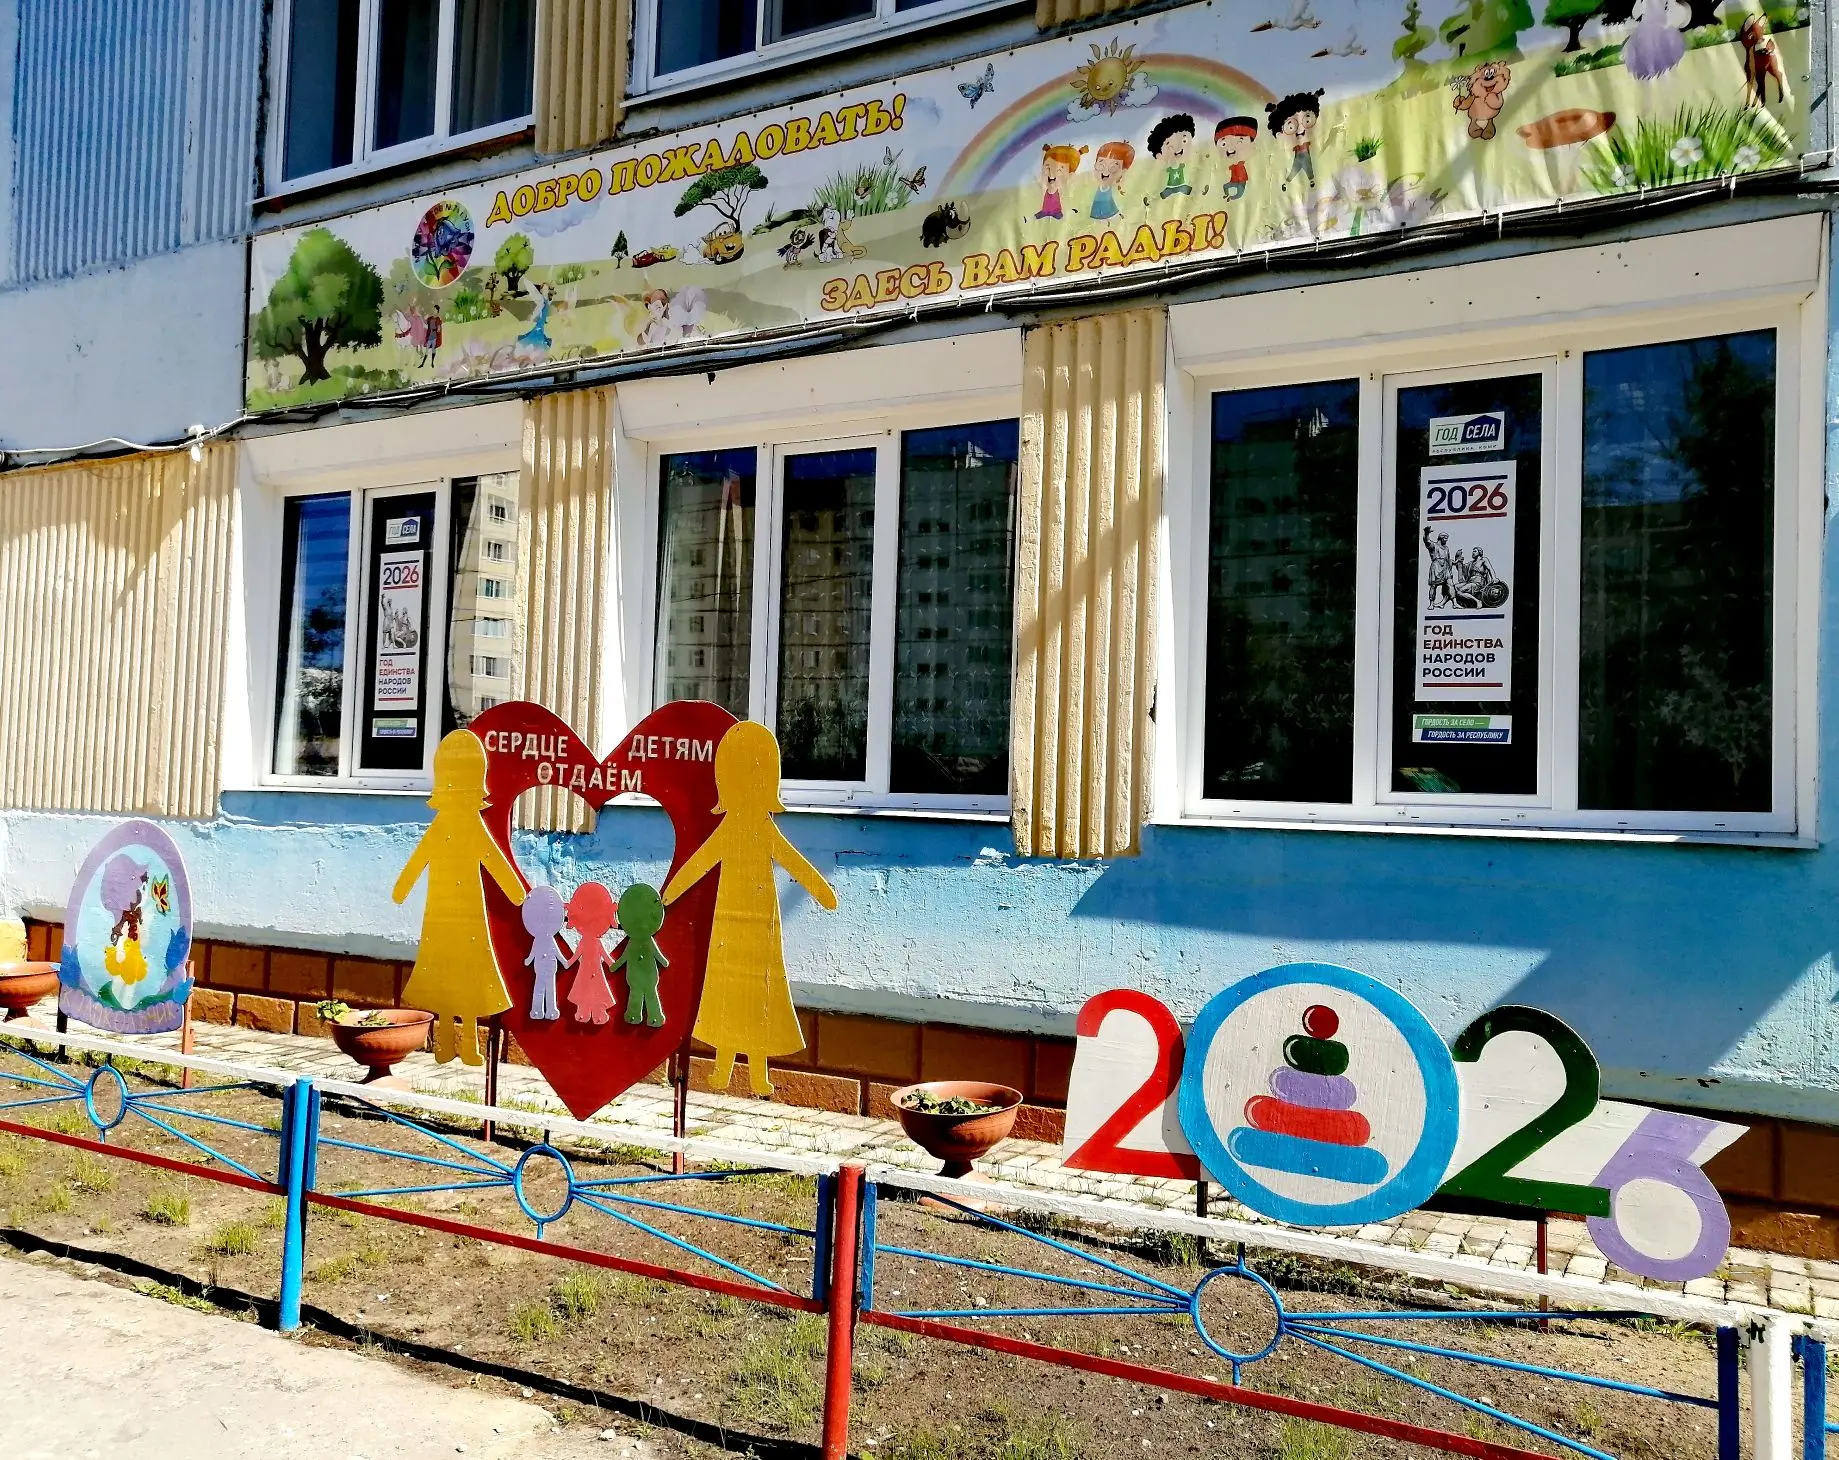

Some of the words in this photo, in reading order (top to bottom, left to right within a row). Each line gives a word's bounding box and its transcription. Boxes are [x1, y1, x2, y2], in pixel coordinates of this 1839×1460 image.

[486, 169, 603, 229] ДОБРО
[609, 94, 907, 195] ПОЖАЛОВАТЬ!
[821, 258, 951, 314] ЗДЕСЬ
[959, 241, 1058, 290] ВАМ
[1064, 211, 1229, 273] РАДЫ!
[1435, 427, 1459, 442] ГОД
[1465, 423, 1496, 439] СЕЛА
[1427, 483, 1508, 514] 2026
[383, 565, 419, 585] 2026
[1423, 625, 1454, 637] ГОД
[1423, 638, 1504, 651] ЕДИНСТВА
[379, 659, 393, 667] ГОД
[1423, 653, 1495, 664] НАРОДОВ
[379, 668, 415, 676] ЕДИНСТВА
[1422, 667, 1486, 678] РОССИИ
[378, 678, 411, 686] НАРОДОВ
[1421, 718, 1449, 727] ГОРДОСТЬ
[1450, 718, 1460, 727] ЗА
[1427, 730, 1457, 740] ГОРДОСТЬ
[1457, 731, 1466, 740] ЗА
[484, 730, 569, 762] СЕРДЦЕ
[628, 734, 713, 762] ДЕТЯМ
[537, 761, 643, 792] ОТДАЁМ
